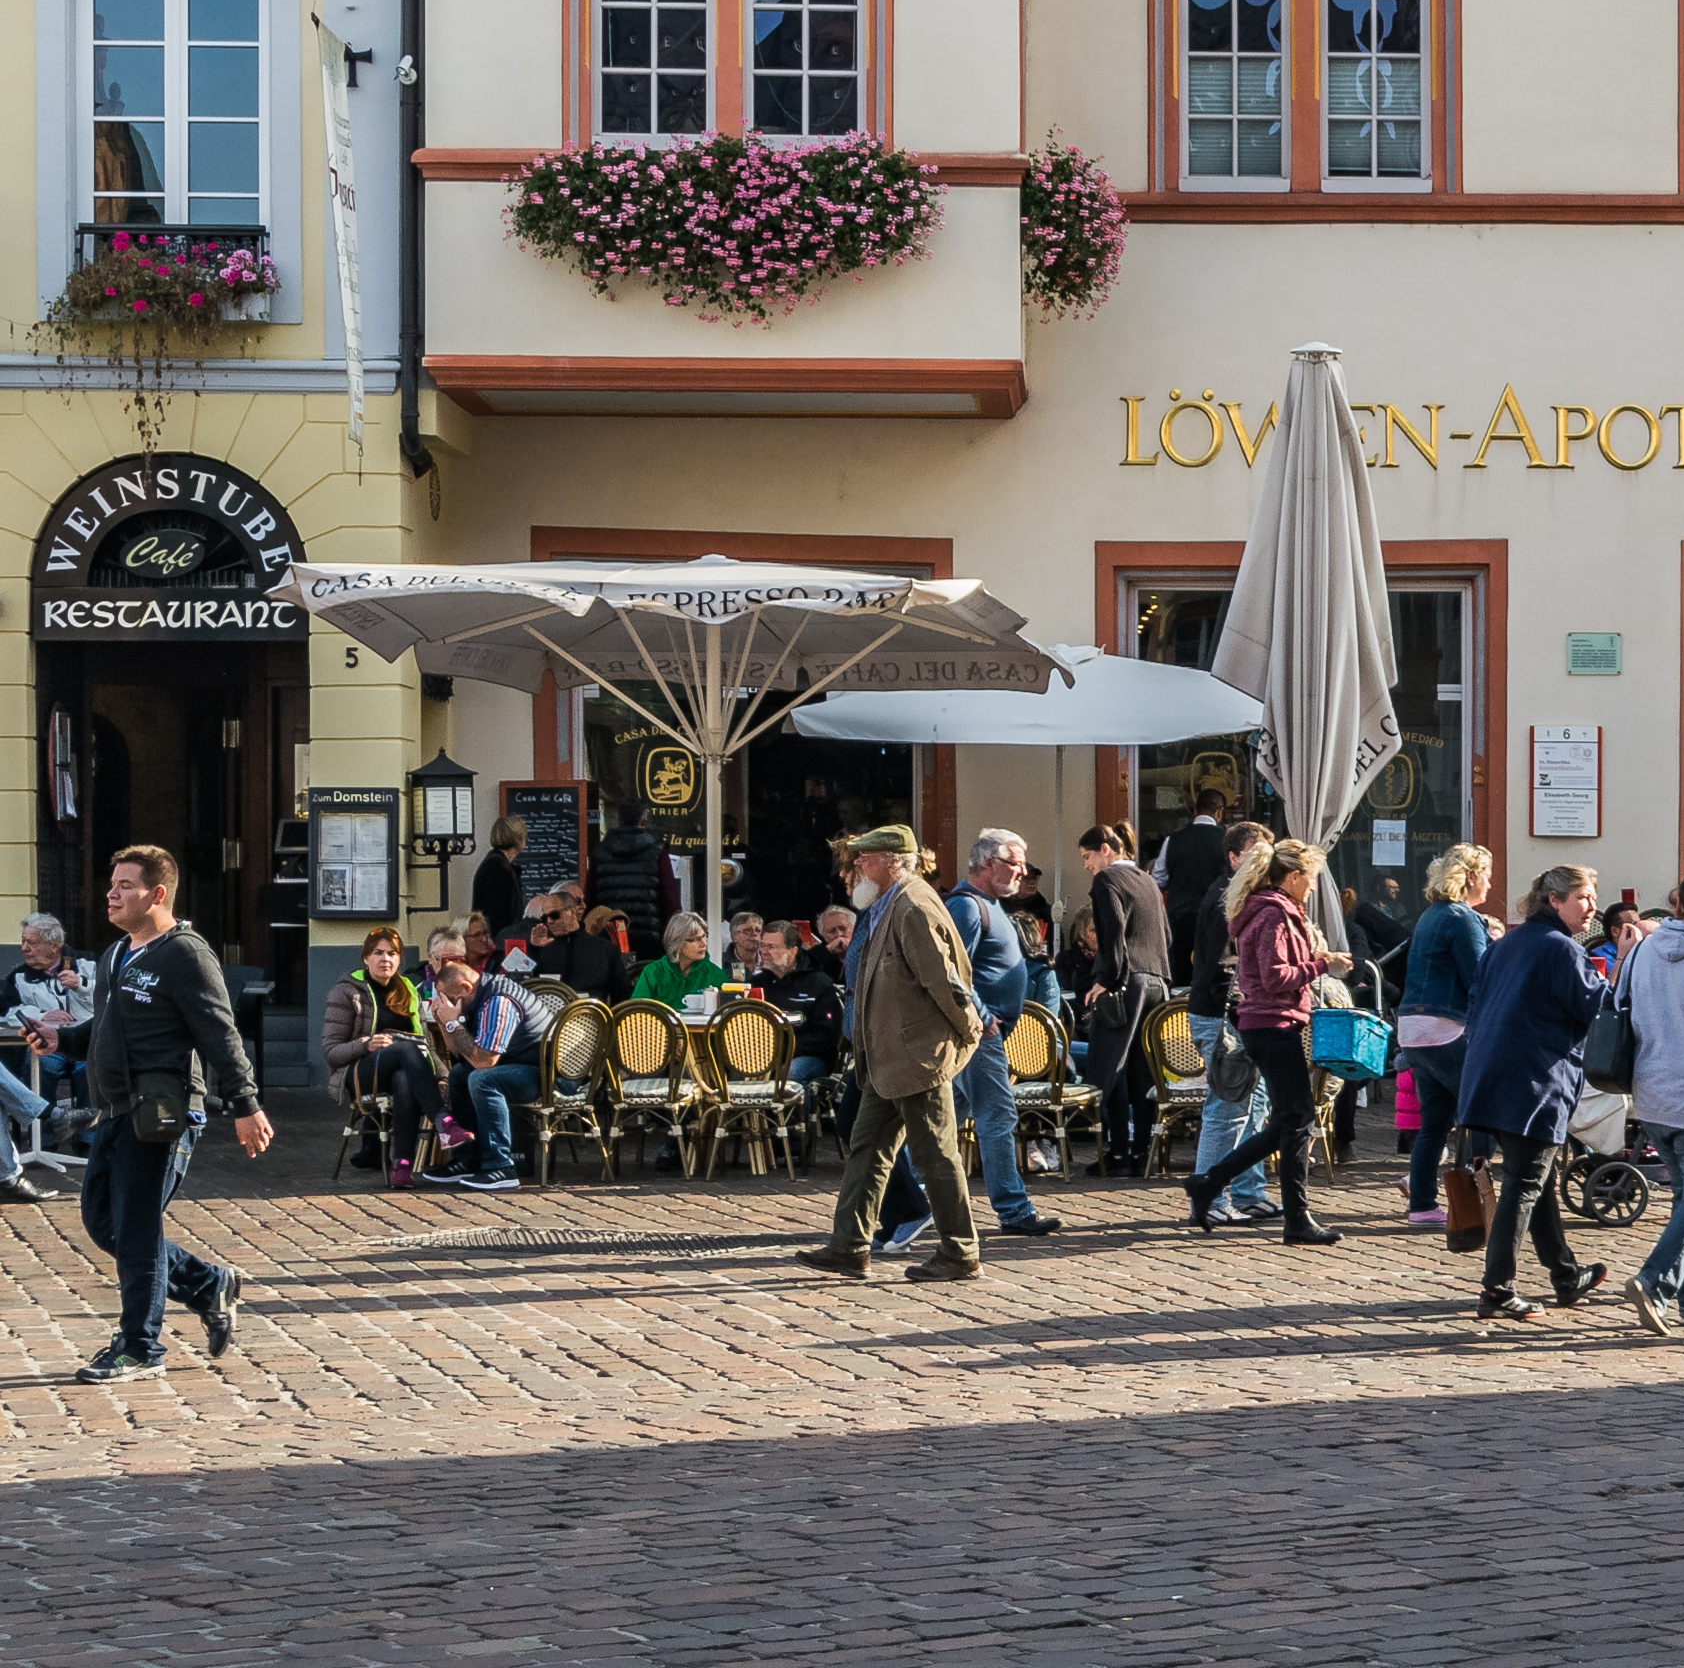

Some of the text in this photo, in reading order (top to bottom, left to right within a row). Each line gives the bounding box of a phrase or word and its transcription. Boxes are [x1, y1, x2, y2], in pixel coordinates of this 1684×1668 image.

[46, 468, 294, 573] WEINSTUBE
[125, 537, 200, 575] Café
[43, 600, 297, 629] RESTAURANT
[345, 647, 359, 668] 5
[615, 728, 648, 744] CASA
[1563, 729, 1571, 740] 6
[312, 791, 394, 803] Zum Domstein
[651, 808, 688, 816] TRIER
